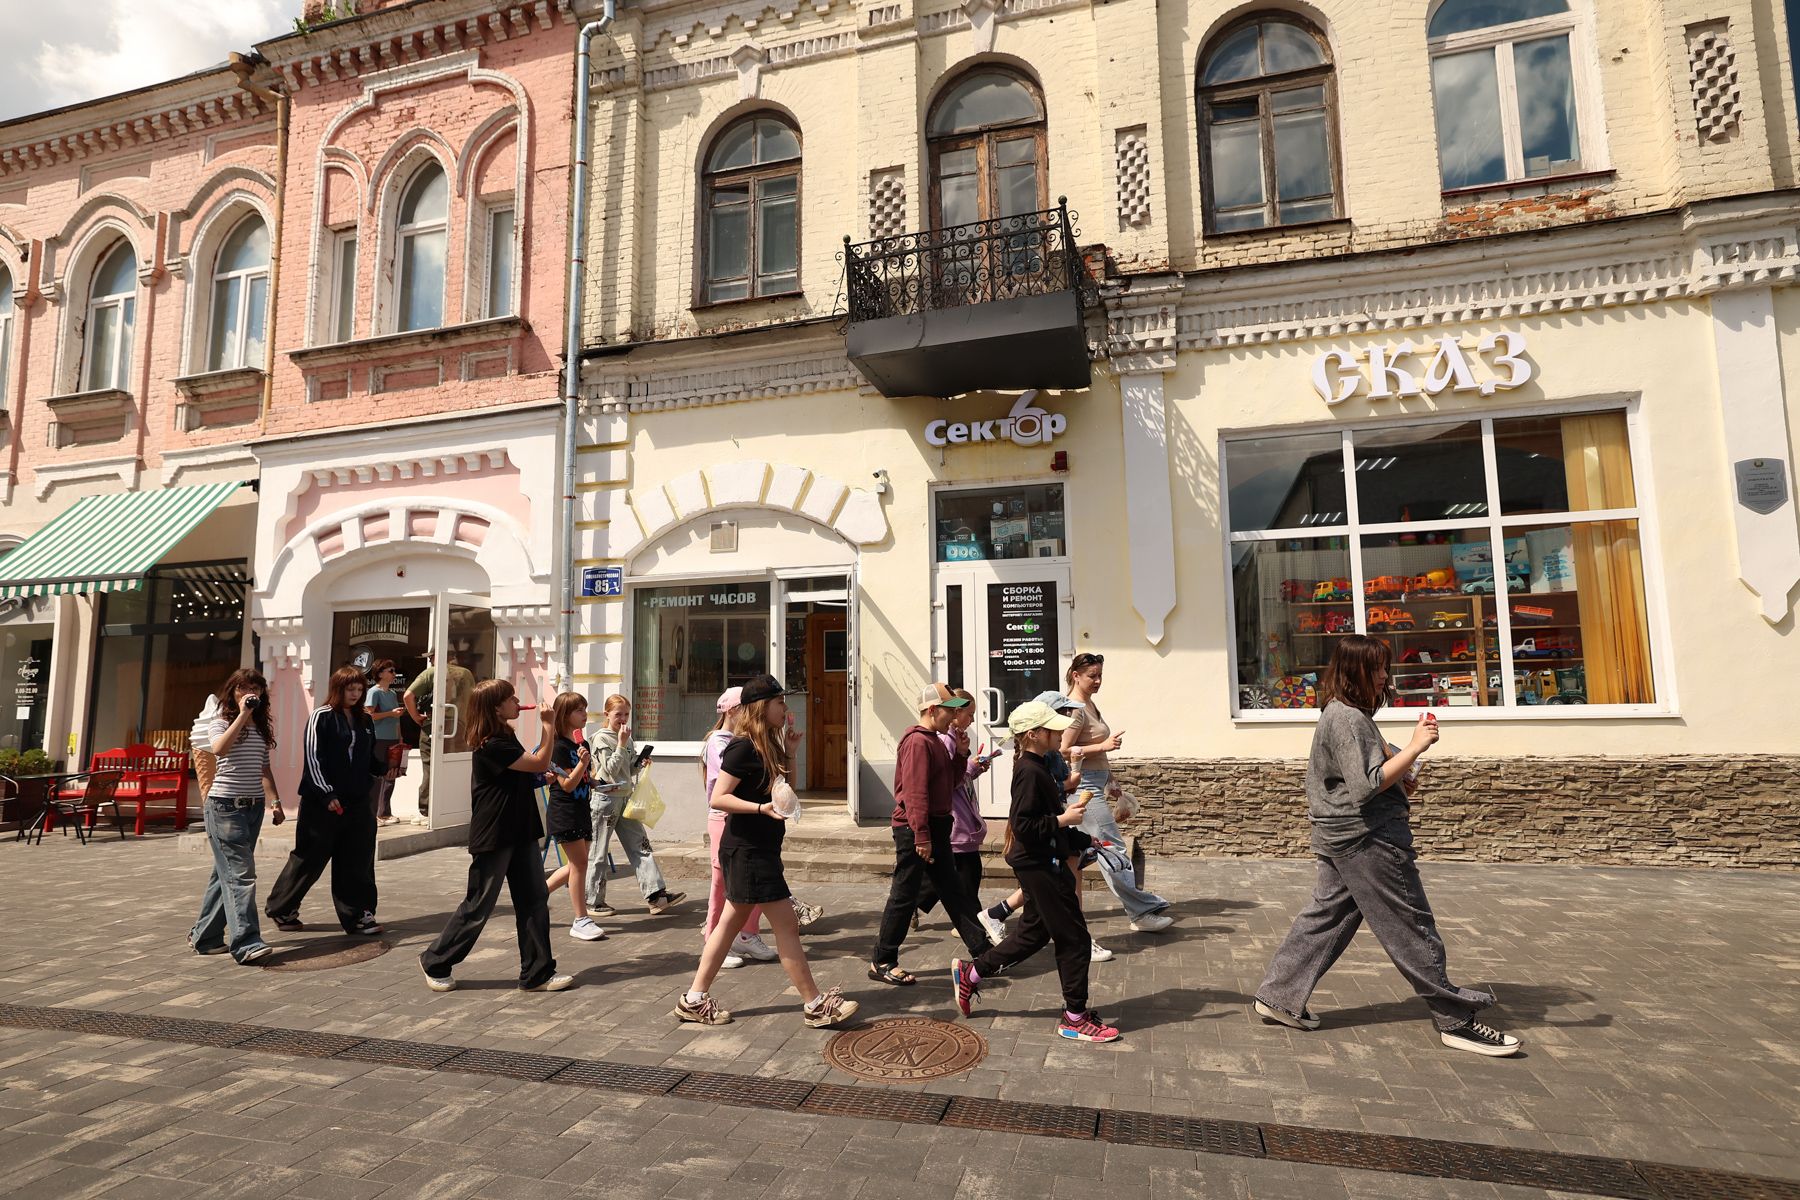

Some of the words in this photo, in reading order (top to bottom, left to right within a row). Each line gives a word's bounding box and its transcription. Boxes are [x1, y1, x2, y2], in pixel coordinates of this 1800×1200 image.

[1312, 331, 1532, 405] СКАЗ
[594, 579, 610, 593] 85
[1003, 586, 1042, 595] СБОРКА
[650, 595, 704, 608] РЕМОНТ
[710, 592, 757, 605] ЧАСОВ
[1010, 594, 1043, 602] РЕМОНТ
[350, 614, 409, 637] ЮВЕЛИРНАЯ
[835, 1045, 956, 1078] БОБРУЙСК
